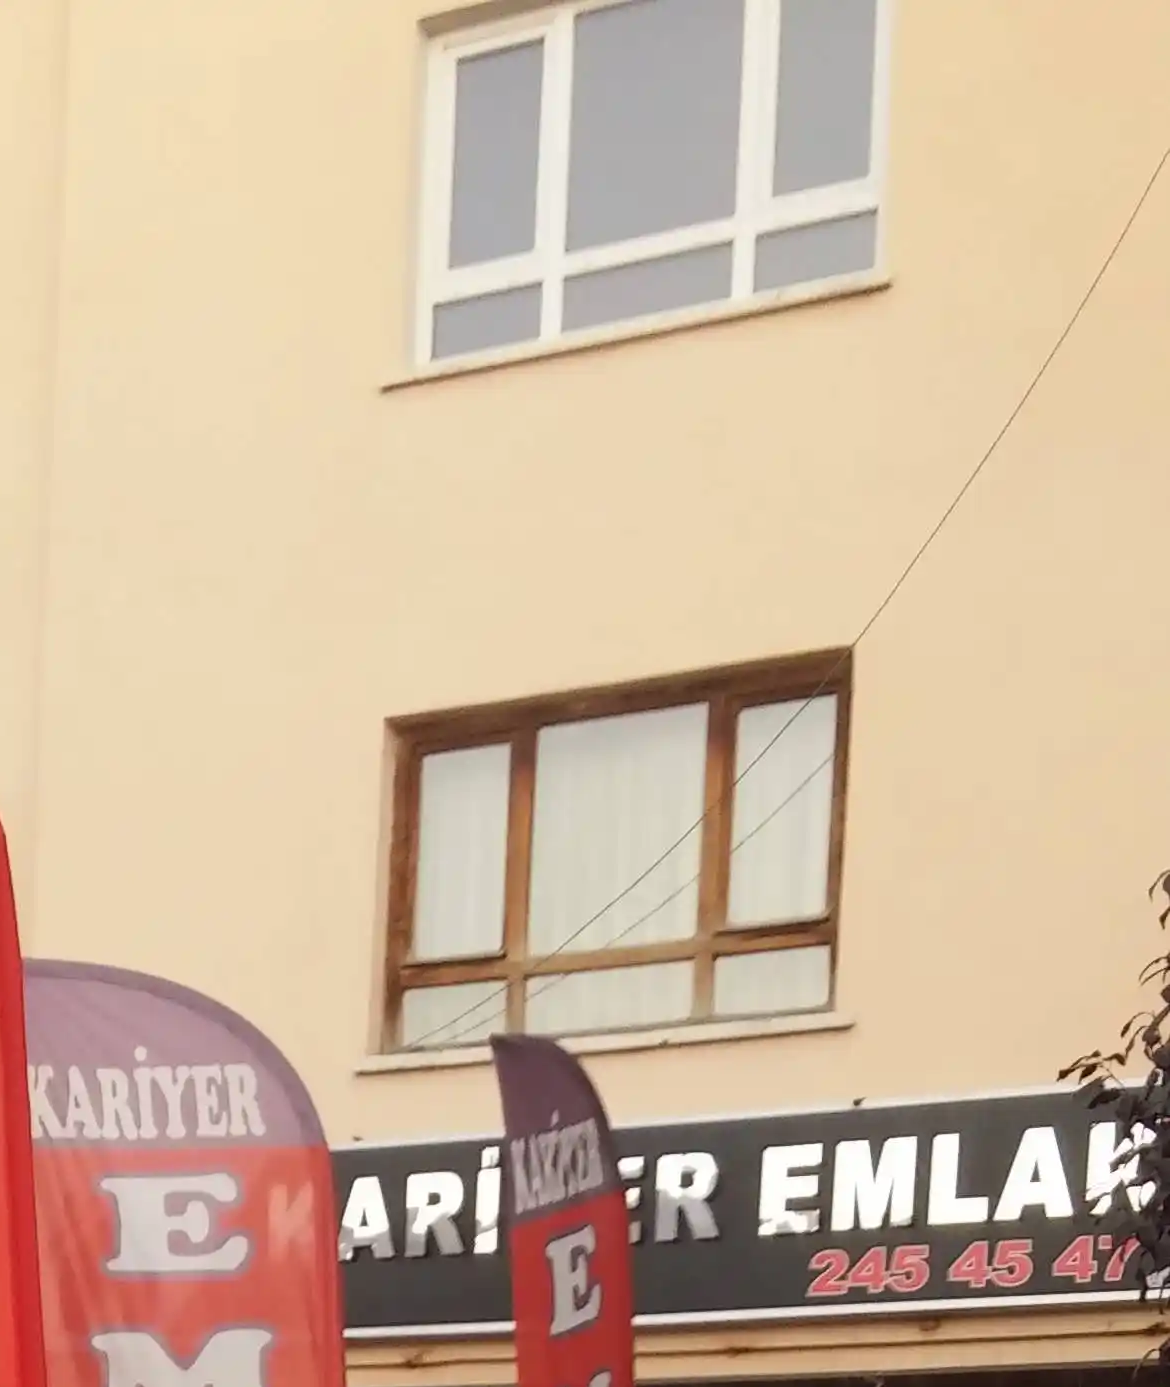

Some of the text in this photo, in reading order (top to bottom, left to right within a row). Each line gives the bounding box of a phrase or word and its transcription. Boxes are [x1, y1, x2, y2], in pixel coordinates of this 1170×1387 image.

[30, 1045, 267, 1141] KARİYER
[758, 1121, 1158, 1237] EMLAK
[806, 1234, 1142, 1298] 245 45 47
